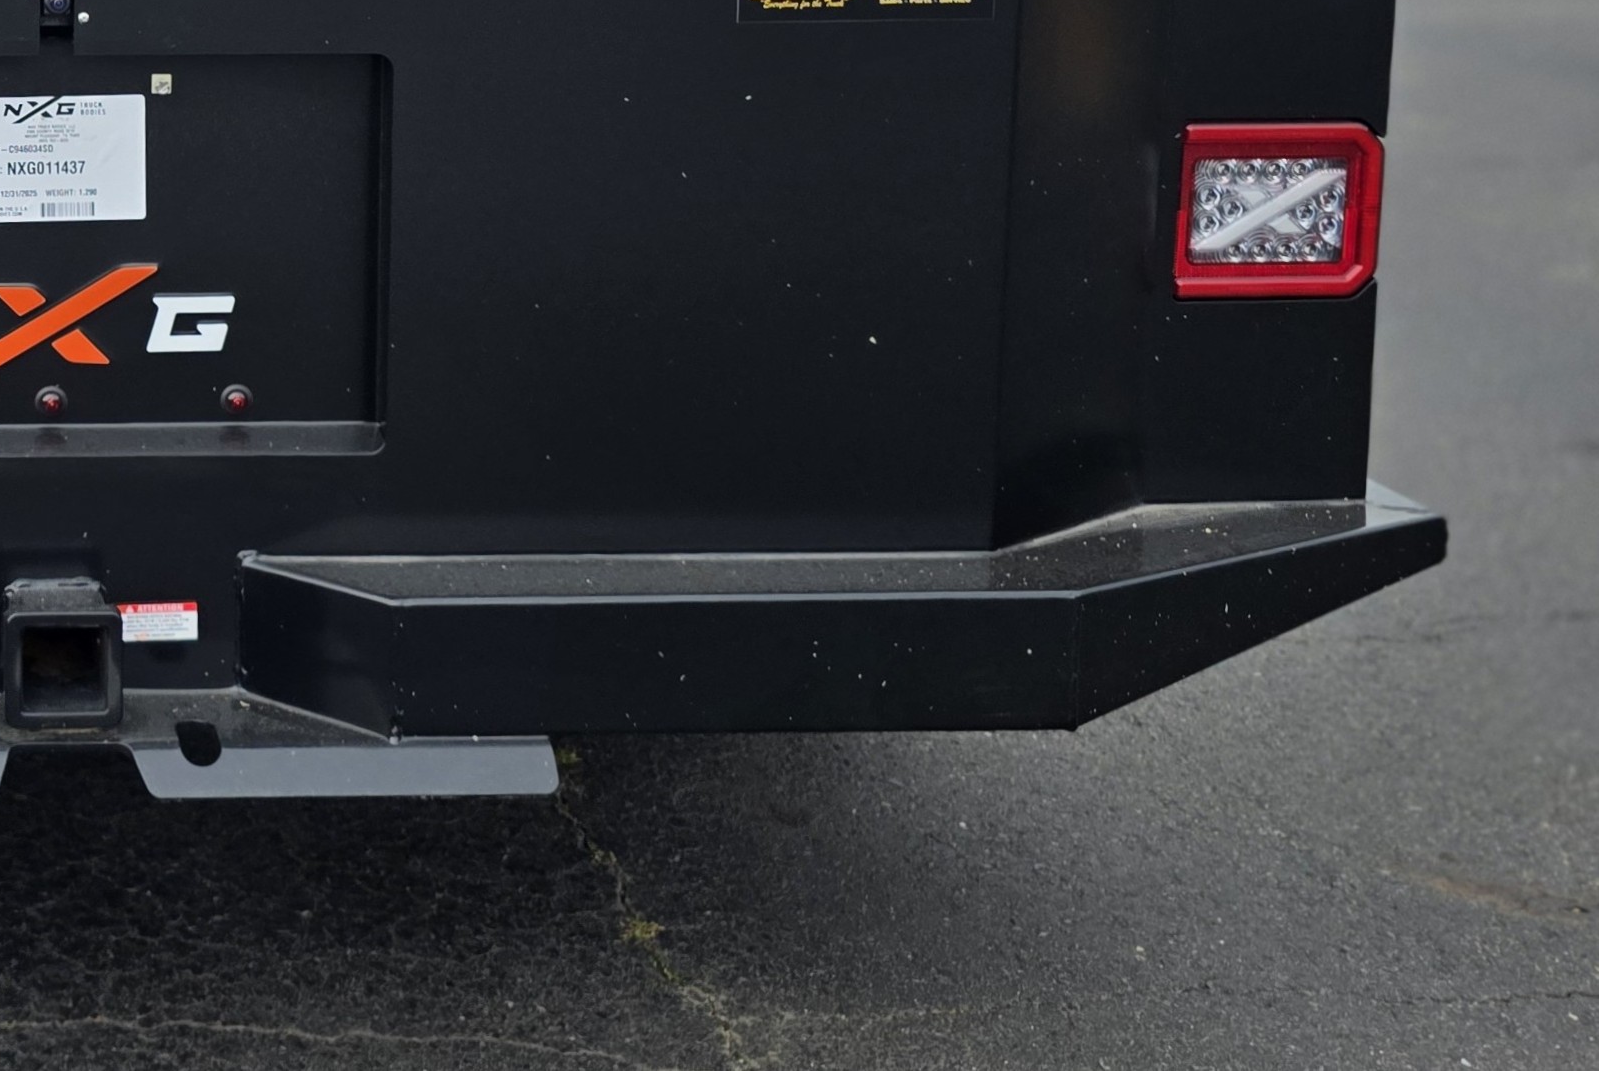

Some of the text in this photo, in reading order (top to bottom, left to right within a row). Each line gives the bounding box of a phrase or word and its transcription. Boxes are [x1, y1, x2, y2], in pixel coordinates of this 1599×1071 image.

[4, 96, 76, 124] NXG
[80, 108, 106, 116] BODIES
[7, 160, 86, 175] NXG011437
[45, 188, 76, 197] WEIGHT:
[137, 604, 184, 612] ATTENTION
